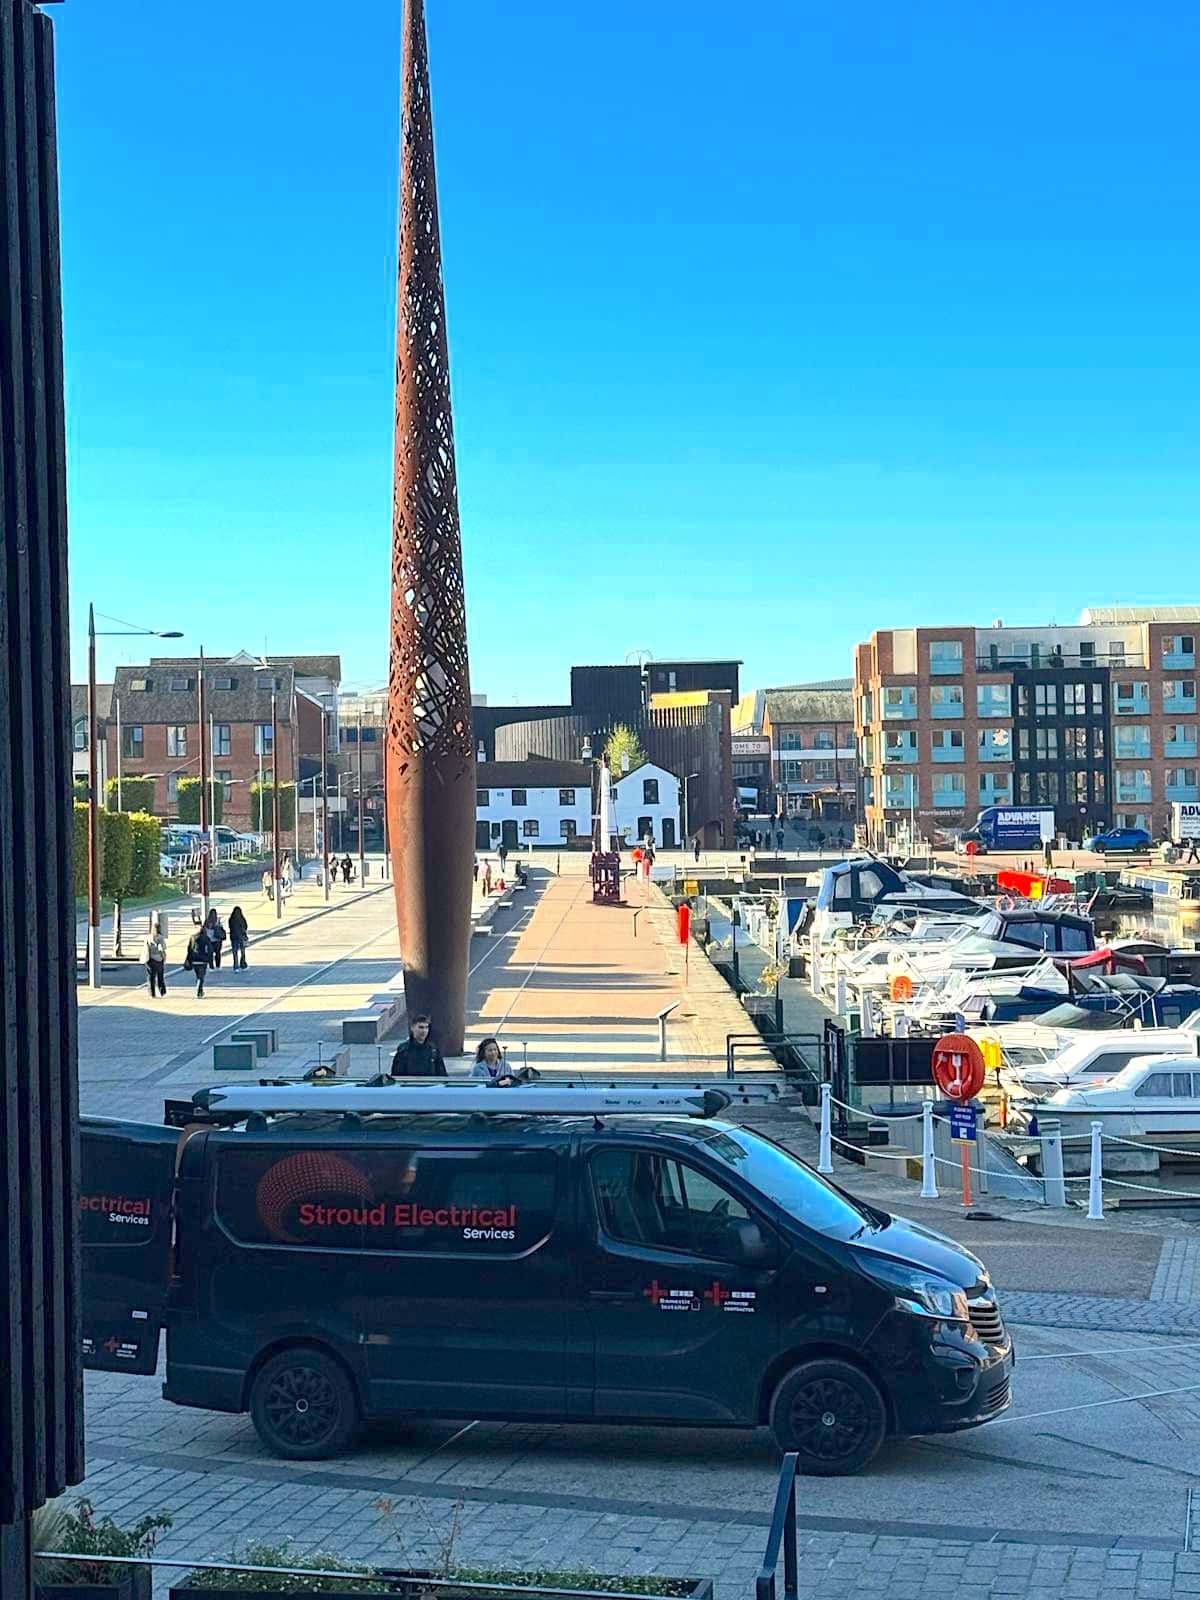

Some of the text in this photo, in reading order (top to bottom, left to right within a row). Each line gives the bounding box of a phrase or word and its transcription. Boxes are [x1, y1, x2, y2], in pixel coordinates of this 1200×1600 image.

[80, 1196, 150, 1215] ectrical
[109, 1212, 149, 1225] Services
[299, 1203, 515, 1227] Stroud Electrical
[463, 1227, 515, 1240] Services
